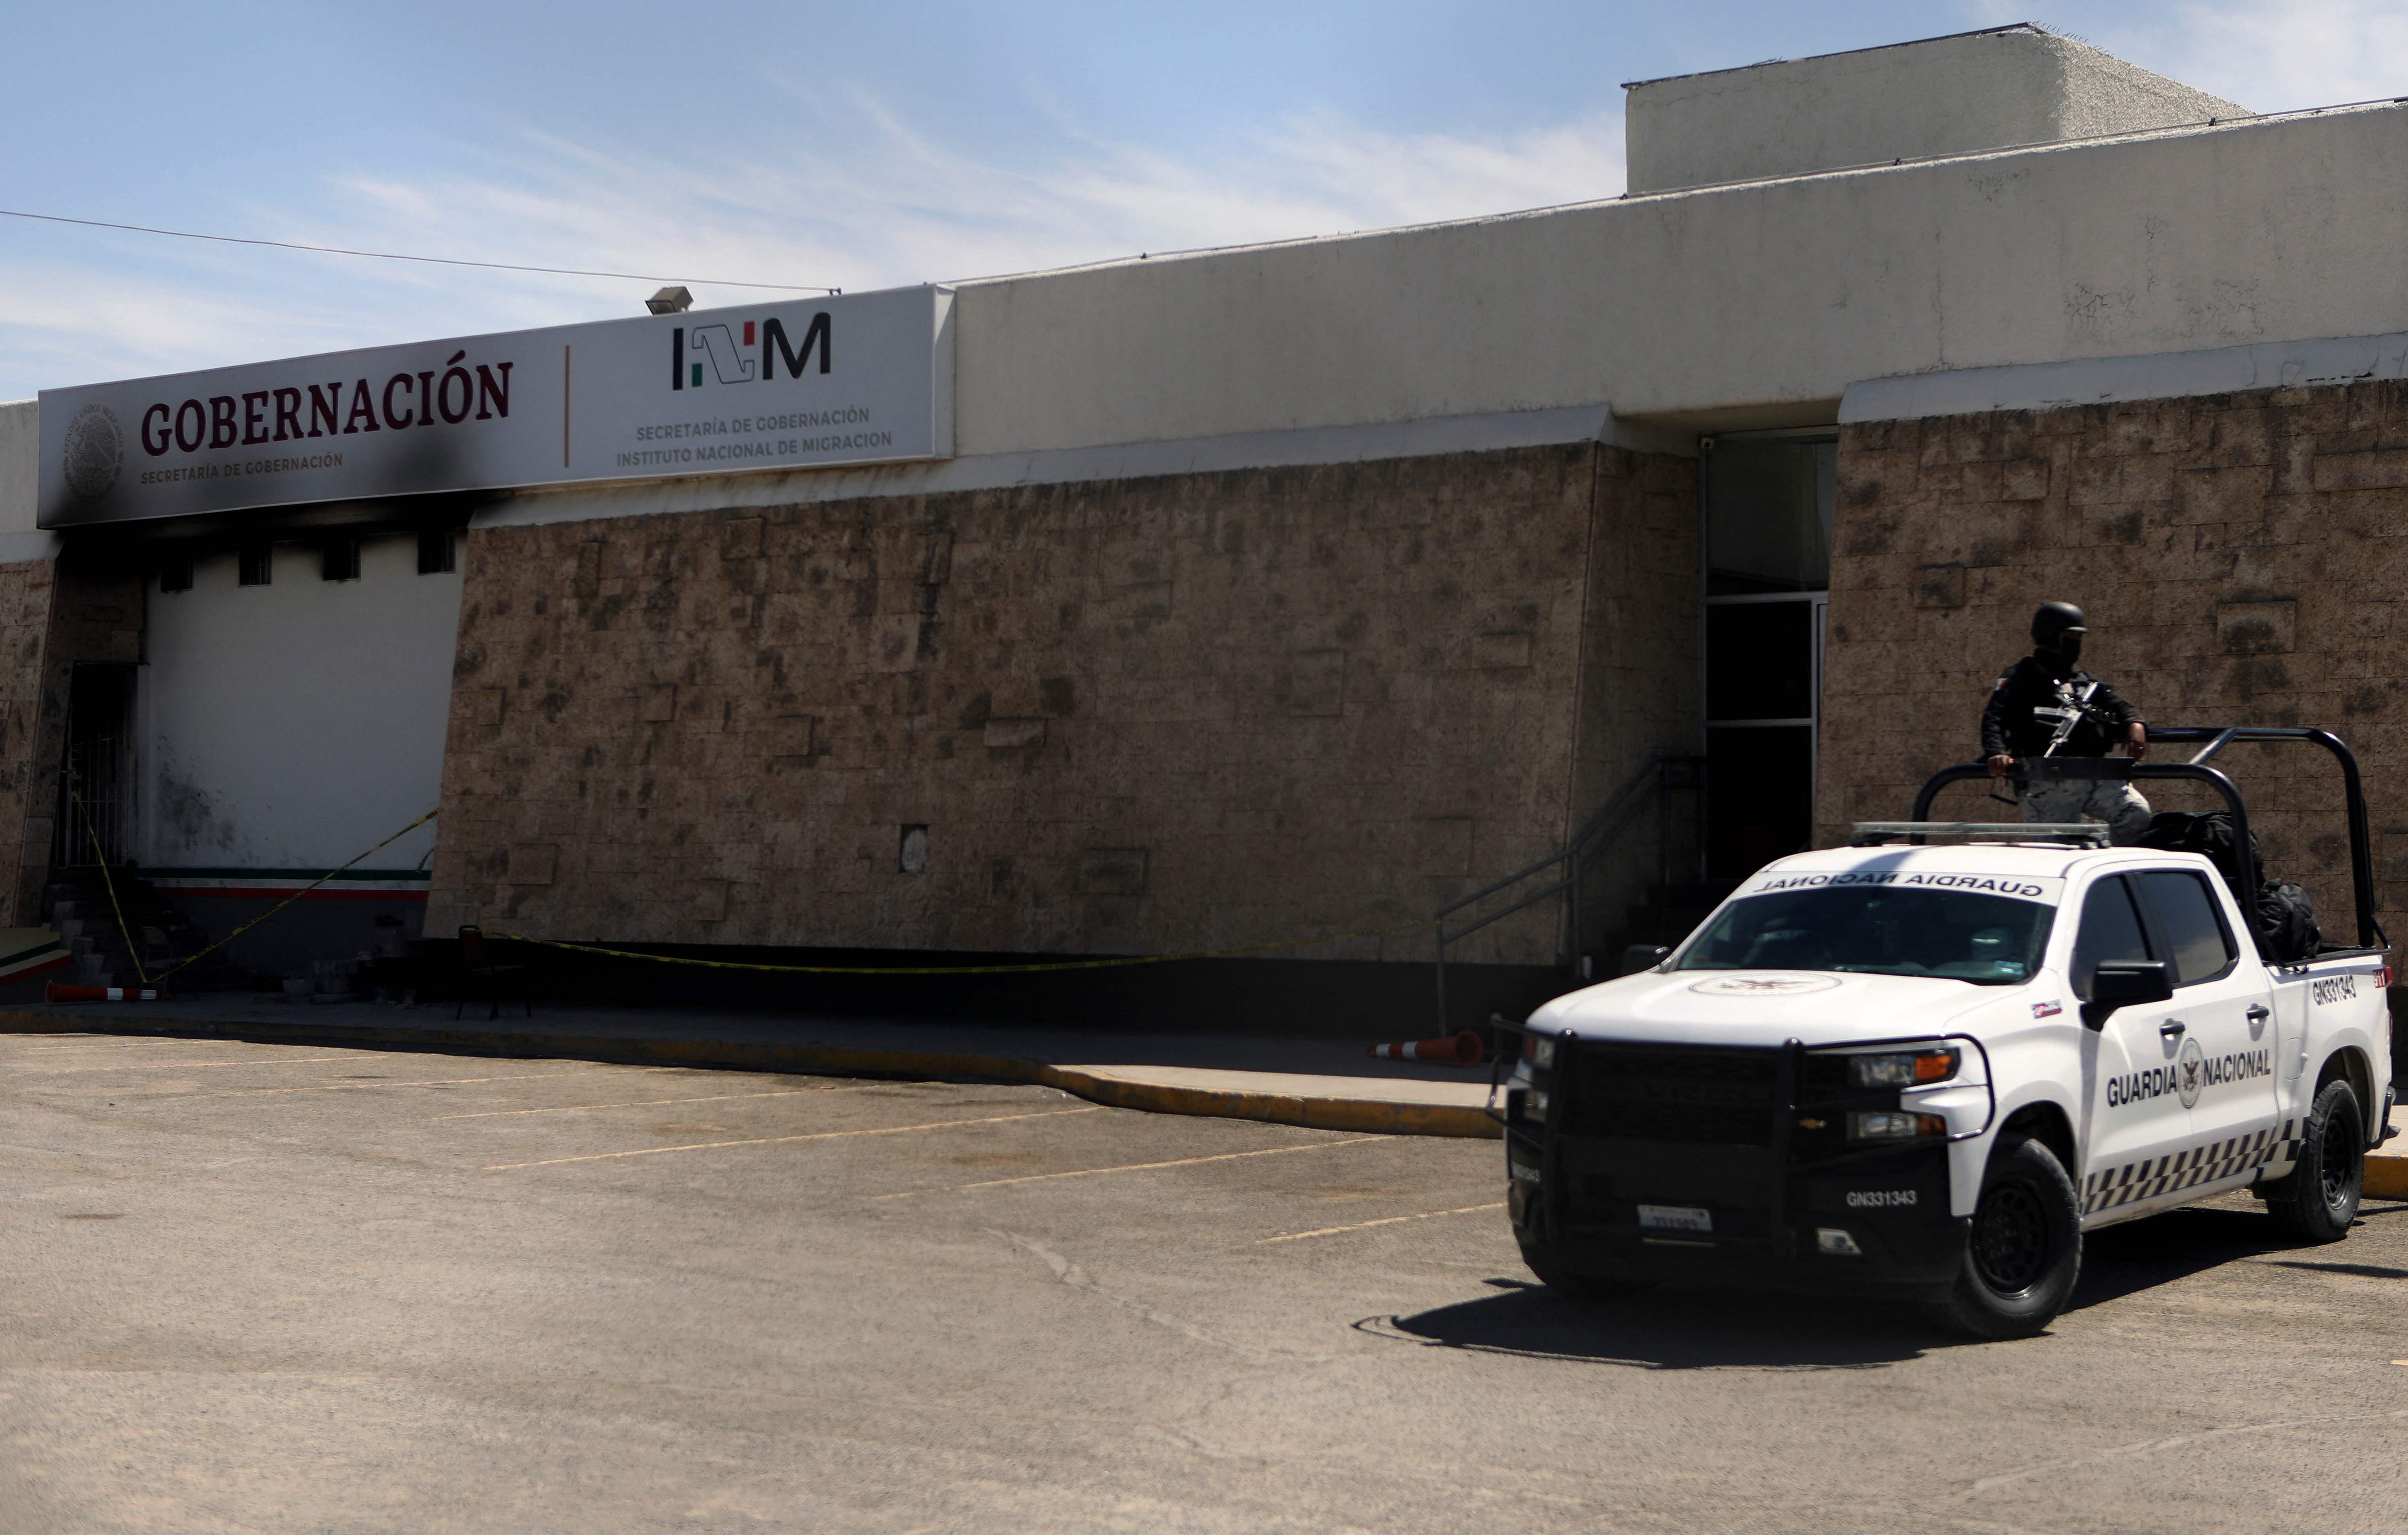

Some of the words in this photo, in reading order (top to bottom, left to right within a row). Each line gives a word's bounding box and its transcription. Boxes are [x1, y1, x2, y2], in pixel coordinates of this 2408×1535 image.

[142, 349, 513, 456] GOBERNACIÓN
[637, 417, 727, 441] SECRETARÍA
[733, 419, 751, 433] DE
[756, 405, 869, 432] GOBERNACIÓN
[141, 462, 218, 485] SECRETARÍA
[224, 463, 240, 476] DE
[246, 451, 343, 475] GOBERNACIÓN
[617, 448, 691, 467] INSTITUTO
[697, 442, 772, 461] NACIONAL
[778, 439, 798, 455] DE
[2313, 975, 2356, 1006] GN331343
[2107, 1064, 2178, 1107] GUARDIA
[2203, 1049, 2271, 1087] NACIONAL
[1846, 1190, 1917, 1206] GN331343
